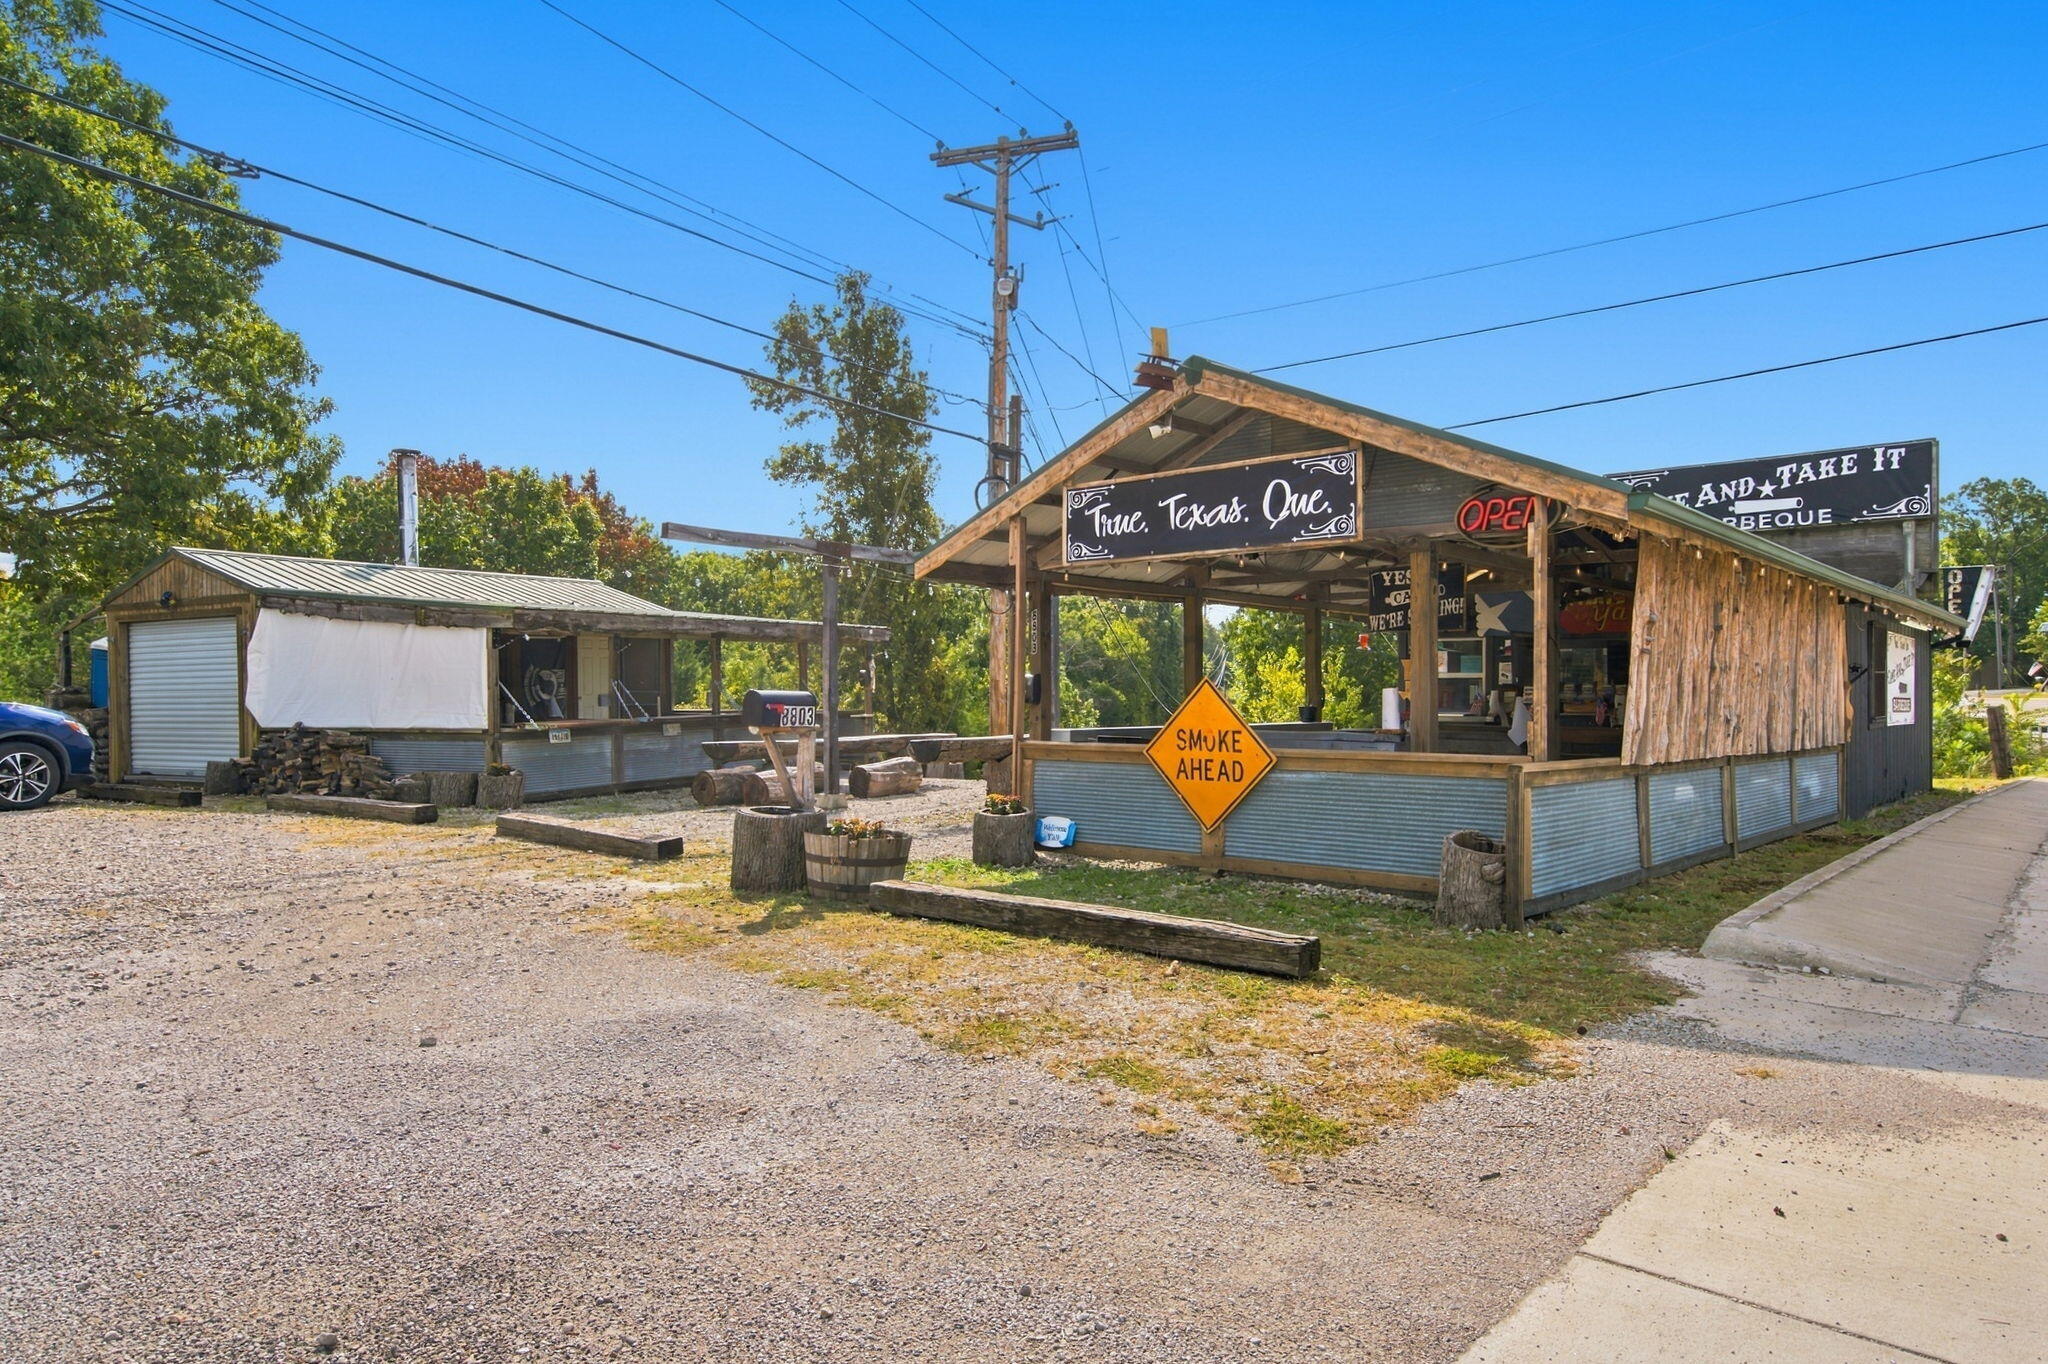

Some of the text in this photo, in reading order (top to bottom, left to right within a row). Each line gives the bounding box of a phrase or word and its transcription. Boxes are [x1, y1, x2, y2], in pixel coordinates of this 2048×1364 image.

[1695, 476, 1757, 508] AND
[1776, 453, 1858, 489] TAKE
[1873, 447, 1906, 472] IT
[1085, 502, 1149, 538] True.
[1158, 493, 1249, 531] Texas.
[1722, 508, 1833, 531] RBEQUE
[1947, 569, 1963, 614] OPE
[1369, 611, 1404, 631] WE'RE
[782, 707, 814, 726] 8803
[1176, 758, 1245, 782] AHEAD
